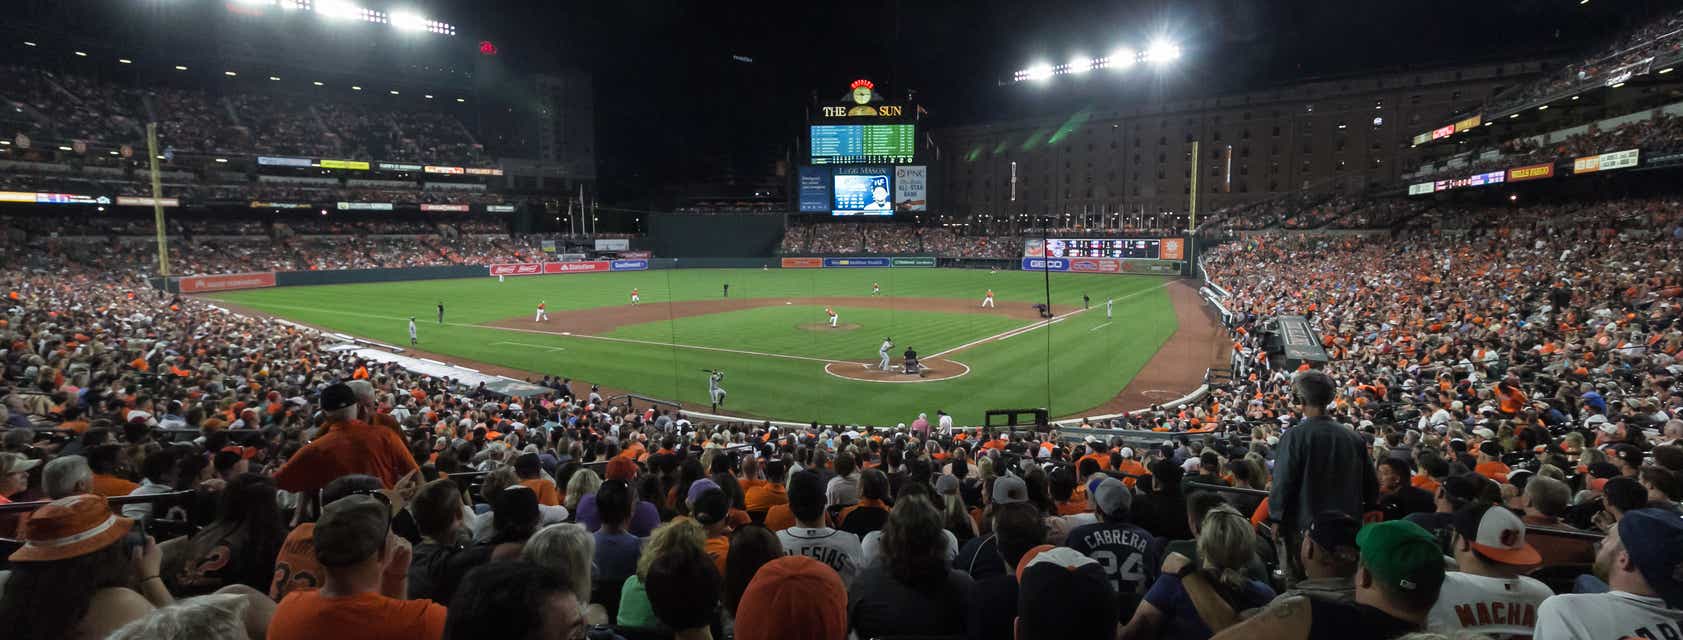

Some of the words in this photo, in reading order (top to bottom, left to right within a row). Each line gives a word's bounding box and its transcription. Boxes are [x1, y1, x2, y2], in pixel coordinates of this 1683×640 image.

[823, 106, 847, 117] THE
[879, 106, 902, 117] SUN
[1031, 260, 1063, 268] GECO
[1083, 529, 1148, 553] CABRERA
